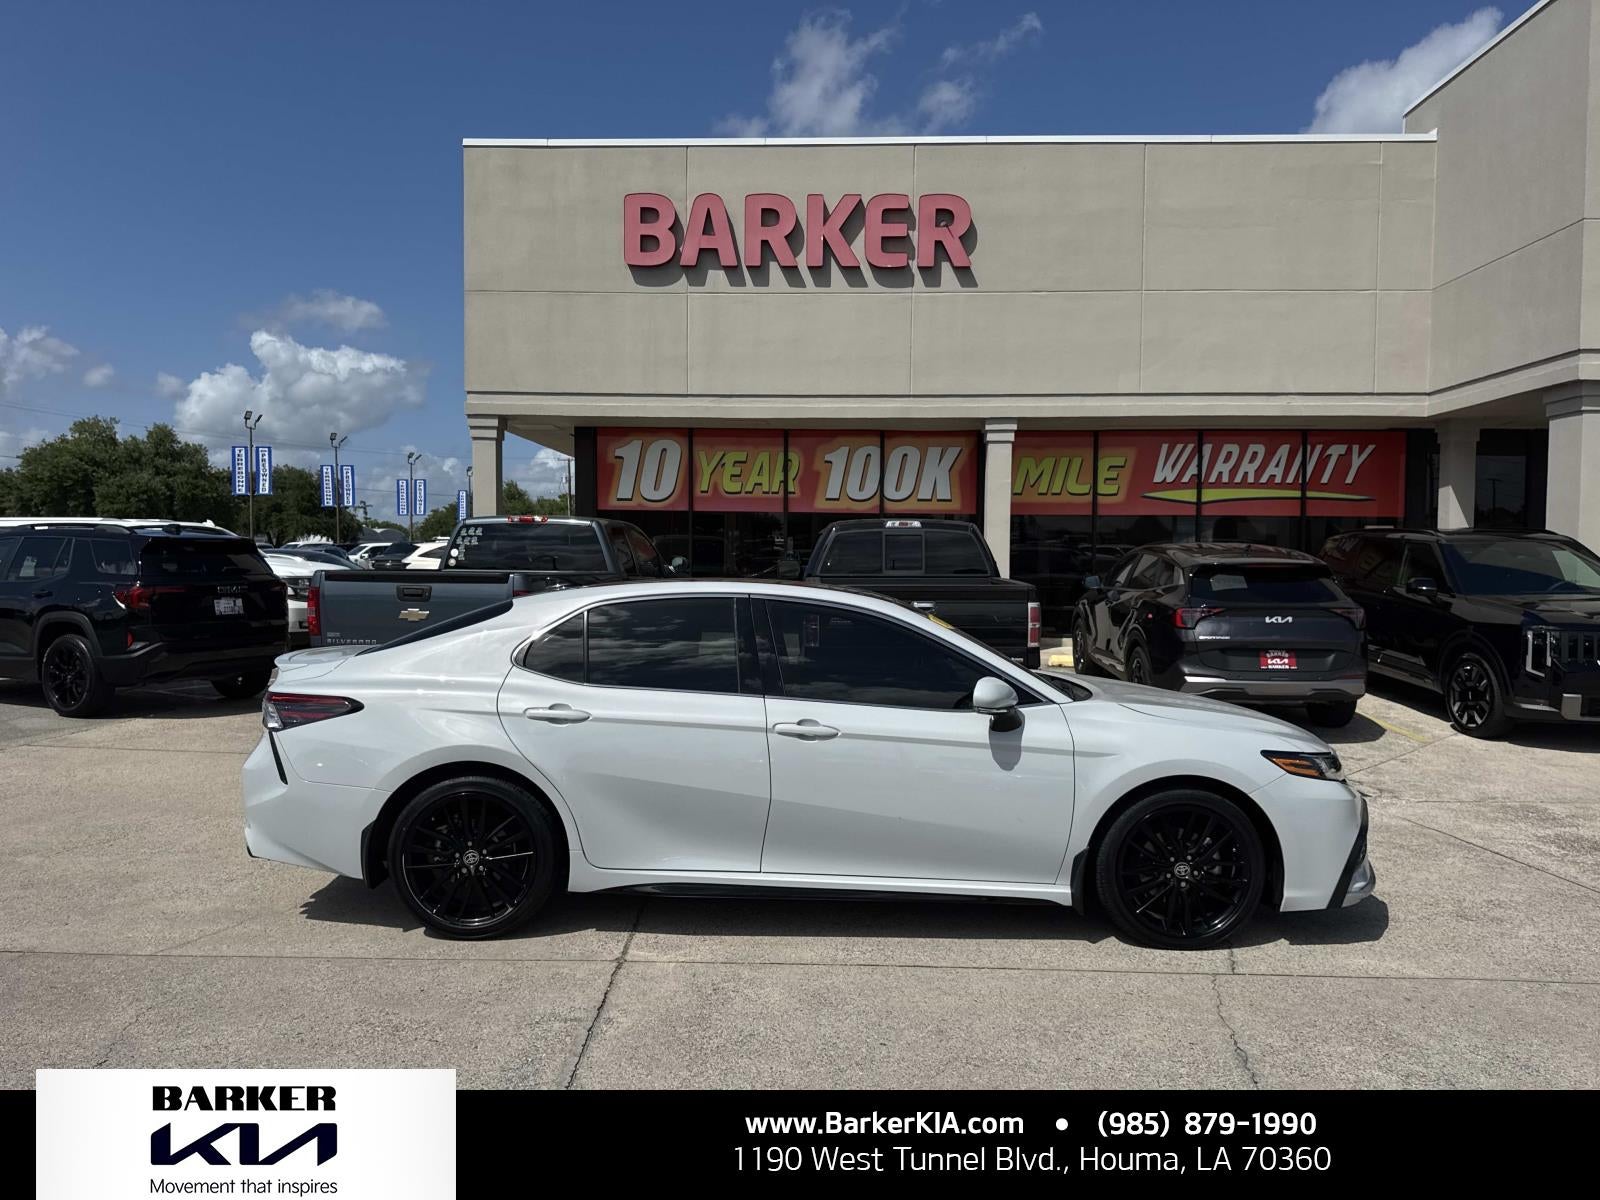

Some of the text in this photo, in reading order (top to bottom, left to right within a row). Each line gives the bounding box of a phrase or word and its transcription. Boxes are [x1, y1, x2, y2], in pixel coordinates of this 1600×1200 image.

[624, 193, 972, 268] BARKER
[614, 439, 1376, 502] 10 YEAR 100K MILE WARRANTY
